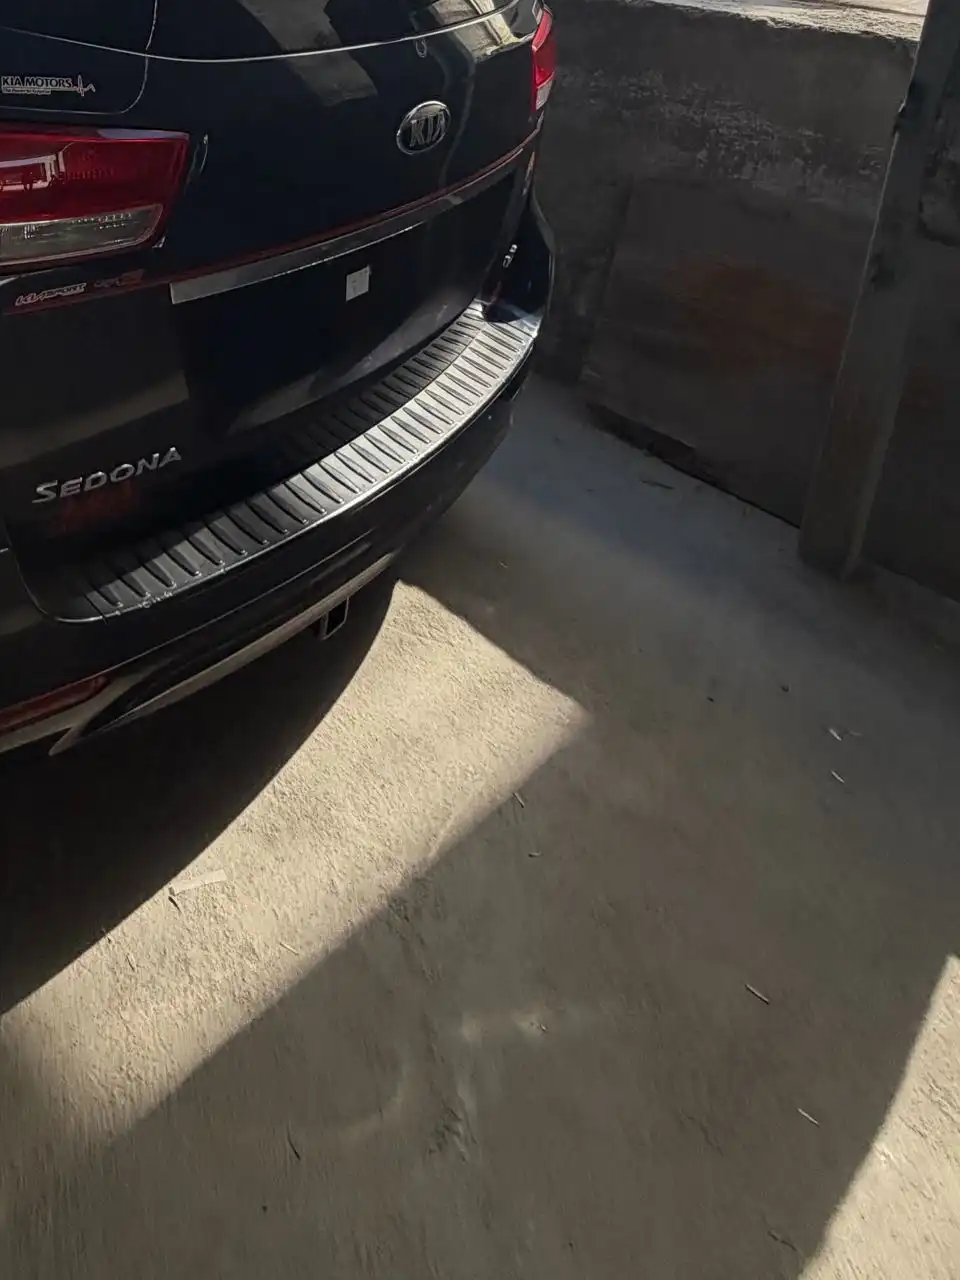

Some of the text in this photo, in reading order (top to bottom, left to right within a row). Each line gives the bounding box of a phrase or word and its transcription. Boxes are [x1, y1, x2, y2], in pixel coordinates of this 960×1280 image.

[2, 76, 73, 89] KIA MOTORS
[31, 446, 182, 504] SEDONA
